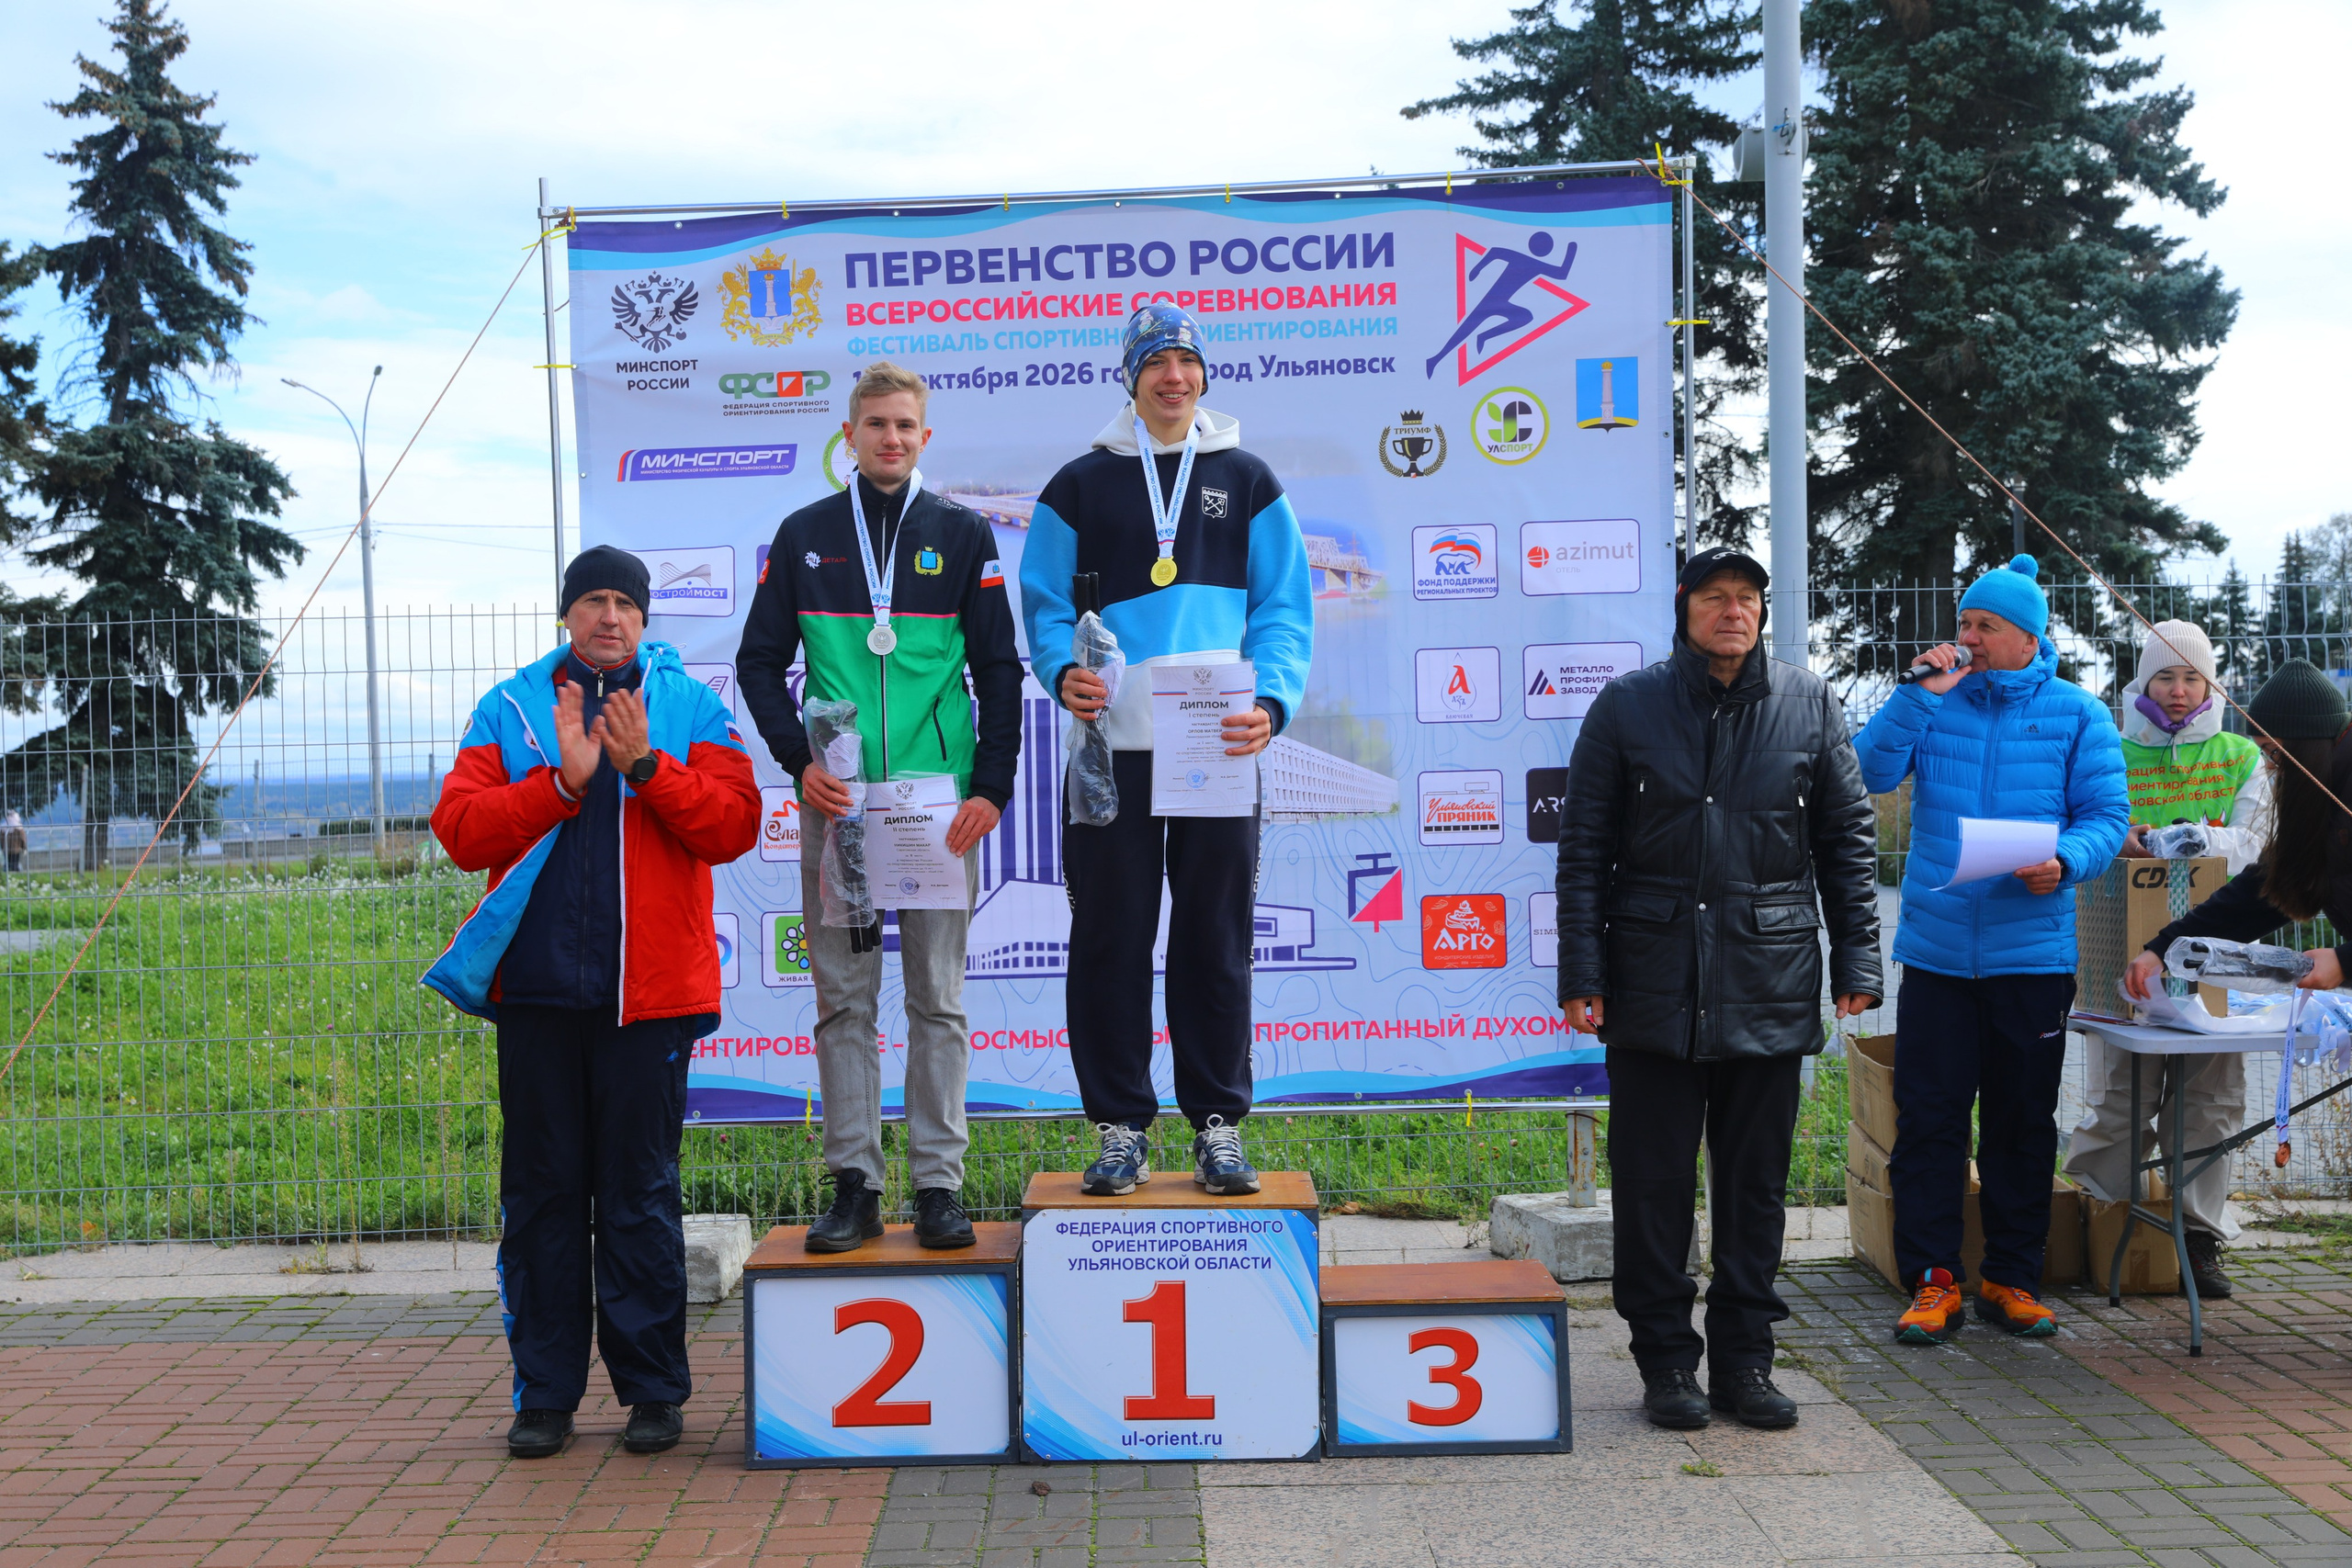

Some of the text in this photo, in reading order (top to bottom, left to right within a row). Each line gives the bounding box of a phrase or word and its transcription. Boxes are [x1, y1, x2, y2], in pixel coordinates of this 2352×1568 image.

[845, 232, 1395, 288] ПЕРВЕНСТВО РОССИИ
[846, 282, 1396, 326] ВСЕРОССИЙСКИЕ СОРЕВНОВАНИЯ
[847, 316, 1397, 356] ФЕСТИВАЛЬ СПОРТИВН РИЕНТИРОВАНИЯ
[616, 359, 698, 374] МИНСПОРТ
[1025, 362, 1094, 387] 2026
[1102, 366, 1123, 384] го
[1209, 361, 1253, 383] род
[1259, 355, 1396, 379] Ульяновск
[628, 377, 691, 391] РОССИИ
[772, 400, 830, 408] СПОРТИВНОГО
[723, 408, 795, 416] ОРИЕНТИРОВАНИЯ
[1394, 425, 1431, 436] ТРИУМФ
[1487, 443, 1533, 454] УЛСПОРТ
[640, 449, 790, 468] МИНСПОРТ
[1555, 541, 1634, 560] azimut
[1418, 576, 1496, 587] ФОНД ПОДДЕРЖКИ
[1560, 686, 1599, 694] ЗАВОД
[1180, 701, 1229, 710] ДИПЛОМ
[2126, 766, 2165, 778] рация
[2131, 791, 2185, 807] новской
[1427, 797, 1497, 823] Ульяновский
[1437, 811, 1497, 822] ПРЯНИК
[884, 814, 933, 826] ДИПЛОМ
[764, 819, 800, 841] Сла
[763, 841, 801, 851] Кондитер
[1256, 1013, 1466, 1043] ПРОПИТАННЫЙ
[1473, 1014, 1570, 1040] ДУХОМ
[1056, 1220, 1283, 1236] ФЕДЕРАЦИЯ СПОРТИВНОГО
[1091, 1239, 1248, 1252] ОРИЕНТИРОВАНИЯ
[1068, 1255, 1272, 1270] УЛЬЯНОВСКОЙ ОБЛАСТИ
[1123, 1280, 1215, 1420] 1
[832, 1296, 932, 1428] 2
[1408, 1326, 1483, 1426] 3
[1122, 1431, 1222, 1446] ul-orient.ru
